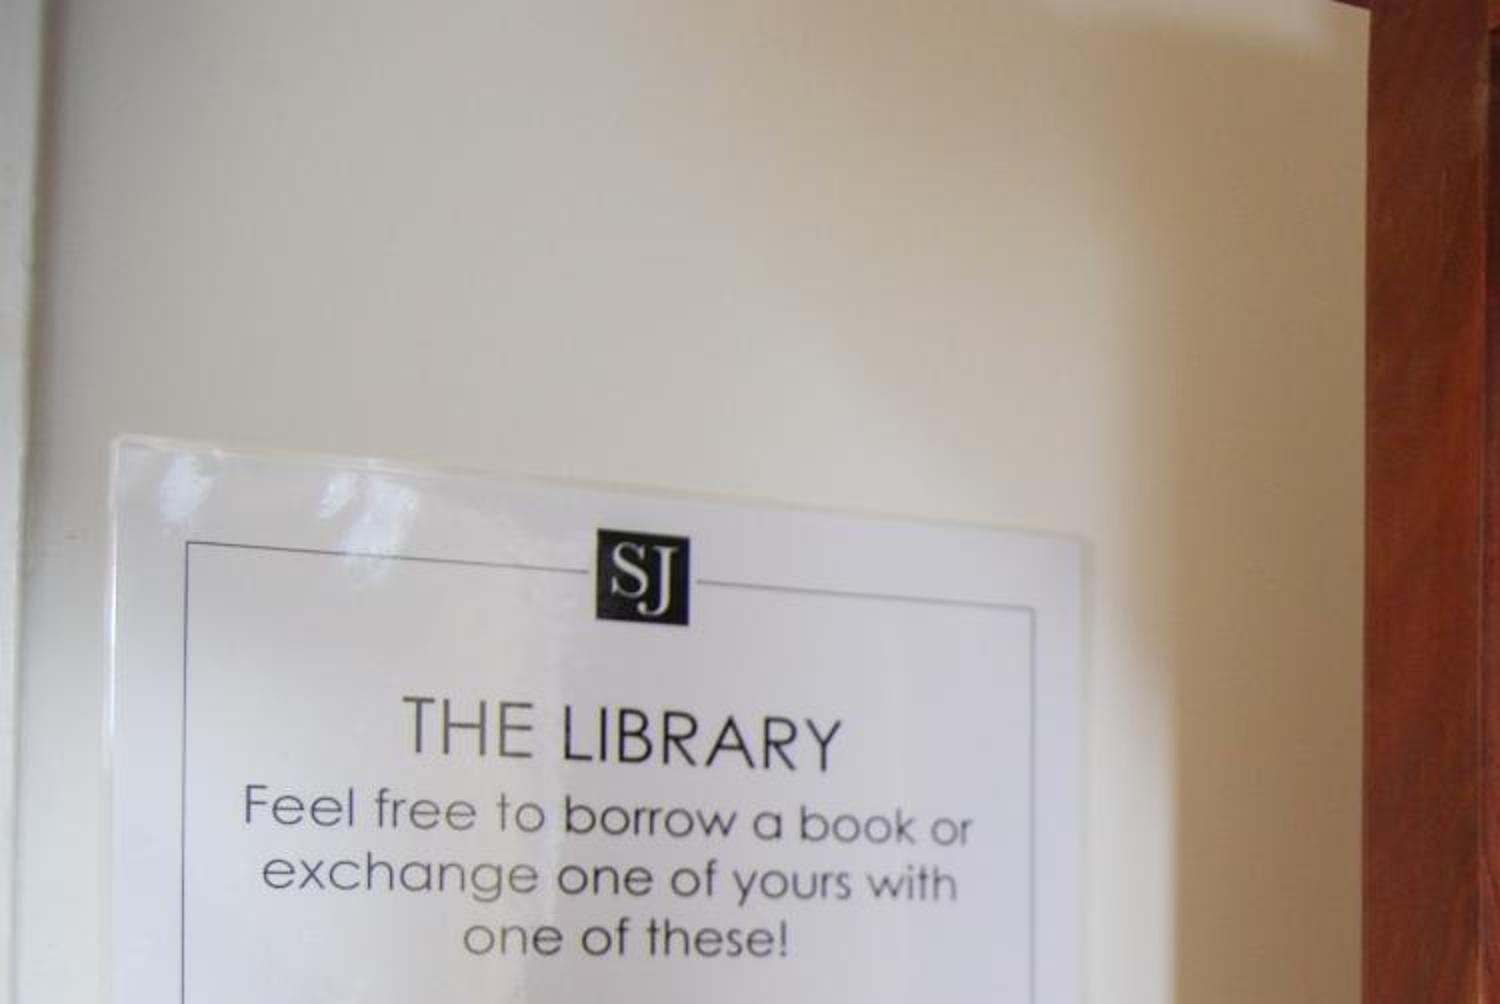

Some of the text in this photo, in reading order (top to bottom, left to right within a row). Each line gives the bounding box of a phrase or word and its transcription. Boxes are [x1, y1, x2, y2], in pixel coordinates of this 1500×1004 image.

[612, 541, 679, 616] SJ
[402, 696, 842, 771] THE LIBRARY
[245, 785, 974, 847] Feel free to borrow a book or
[262, 852, 957, 907] exchange one of yours with
[463, 917, 788, 959] one of these!
